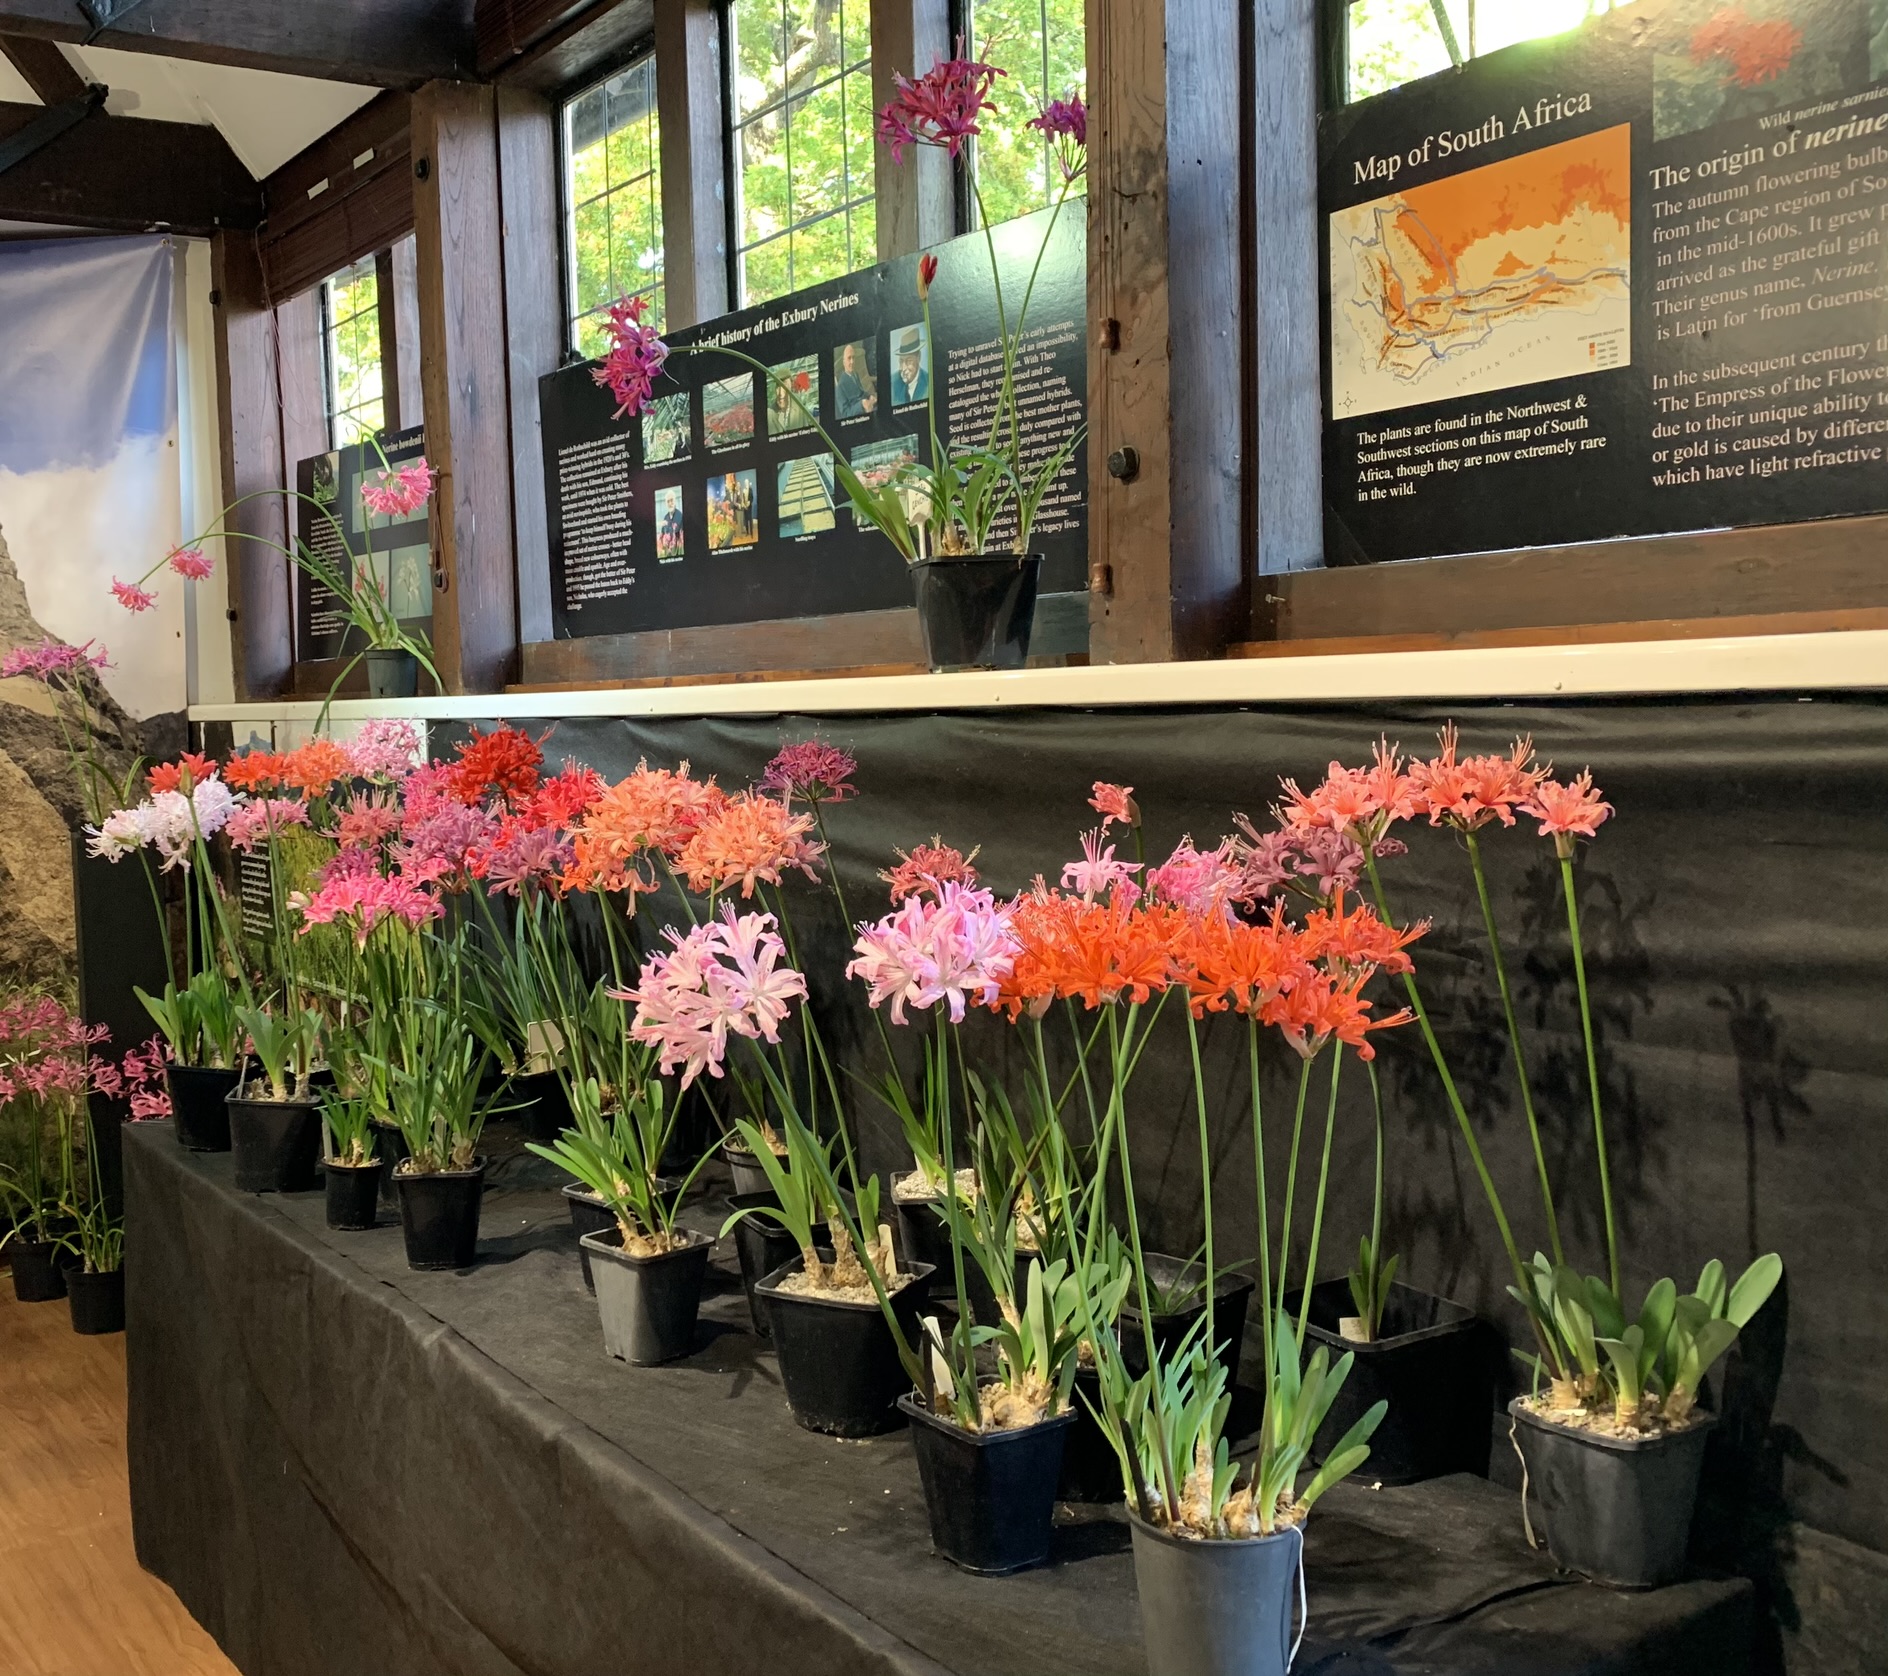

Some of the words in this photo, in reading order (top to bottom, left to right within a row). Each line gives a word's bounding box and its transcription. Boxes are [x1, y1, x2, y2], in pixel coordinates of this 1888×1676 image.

[1758, 110, 1790, 130] Wild
[1794, 101, 1838, 121] nerine
[1841, 86, 1888, 108] sarnie
[1353, 155, 1400, 186] Map
[1408, 136, 1434, 166] of
[1438, 115, 1504, 158] South
[1512, 92, 1592, 134] Africa
[1649, 165, 1691, 190] The
[1697, 144, 1764, 179] origin
[1773, 130, 1801, 157] of
[1804, 113, 1888, 150] nerine
[1652, 200, 1682, 219] The
[1687, 184, 1749, 210] autumn
[1756, 161, 1841, 193] flowering
[1653, 224, 1690, 243] from
[1695, 216, 1720, 233] the
[1725, 204, 1769, 226] Cape
[1774, 191, 1831, 215] region
[1837, 178, 1860, 199] of
[1862, 175, 1888, 194] So
[1656, 251, 1672, 267] in
[1677, 245, 1702, 262] the
[1706, 222, 1802, 256] mid-1600s.
[1808, 215, 1822, 232] It
[1828, 206, 1874, 232] grew
[1656, 265, 1713, 292] arrived
[1719, 265, 1736, 278] as
[1741, 255, 1767, 273] the
[1772, 236, 1841, 270] grateful
[1847, 227, 1881, 255] gift
[721, 326, 752, 347] history
[753, 319, 765, 336] of
[765, 316, 780, 332] the
[782, 305, 818, 328] Exbury
[820, 292, 859, 316] Nerines
[1652, 295, 1695, 317] Their
[1700, 287, 1748, 311] genus
[1657, 325, 1670, 340] is
[1676, 315, 1717, 337] Latin
[1724, 311, 1747, 328] for
[948, 347, 967, 359] Trying
[975, 338, 997, 352] unravel
[1030, 326, 1045, 337] early
[1047, 320, 1074, 333] attempts
[1012, 381, 1041, 394] ollection,
[1652, 374, 1668, 390] In
[1673, 370, 1698, 387] the
[1702, 354, 1796, 382] subsequent
[1802, 341, 1870, 365] century
[1694, 384, 1765, 408] Empress
[1771, 376, 1791, 396] of
[1795, 373, 1822, 392] the
[1827, 365, 1888, 387] Flowe
[1357, 432, 1377, 446] The
[1379, 427, 1412, 445] plants
[1414, 424, 1432, 436] are
[1434, 414, 1467, 433] found
[1470, 414, 1482, 427] in
[1485, 410, 1503, 424] the
[1506, 398, 1571, 420] Northwest
[1575, 394, 1588, 408] &
[1652, 422, 1681, 439] due
[1685, 418, 1701, 433] to
[1706, 410, 1745, 431] their
[1749, 404, 1808, 425] unique
[1813, 392, 1872, 415] ability
[1357, 444, 1411, 465] Southwest
[1414, 438, 1459, 458] sections
[1462, 436, 1477, 448] on
[1480, 430, 1502, 446] this
[1504, 427, 1531, 442] map
[1534, 421, 1550, 437] of
[1551, 415, 1588, 433] South
[1358, 466, 1394, 483] Africa,
[1396, 460, 1434, 478] though
[1437, 457, 1461, 472] they
[1464, 454, 1482, 467] are
[1485, 450, 1511, 464] now
[1514, 437, 1577, 461] extremely
[1580, 436, 1607, 450] rare
[1652, 449, 1669, 463] or
[1673, 440, 1709, 464] gold
[1714, 438, 1728, 454] is
[1732, 428, 1791, 452] caused
[1796, 427, 1818, 446] by
[1823, 418, 1888, 440] differe
[1652, 465, 1700, 487] which
[1705, 462, 1745, 481] have
[1750, 455, 1789, 477] light
[1794, 444, 1882, 470] refractive
[1358, 488, 1368, 502] in
[1371, 485, 1387, 500] the
[1389, 483, 1417, 497] wild.
